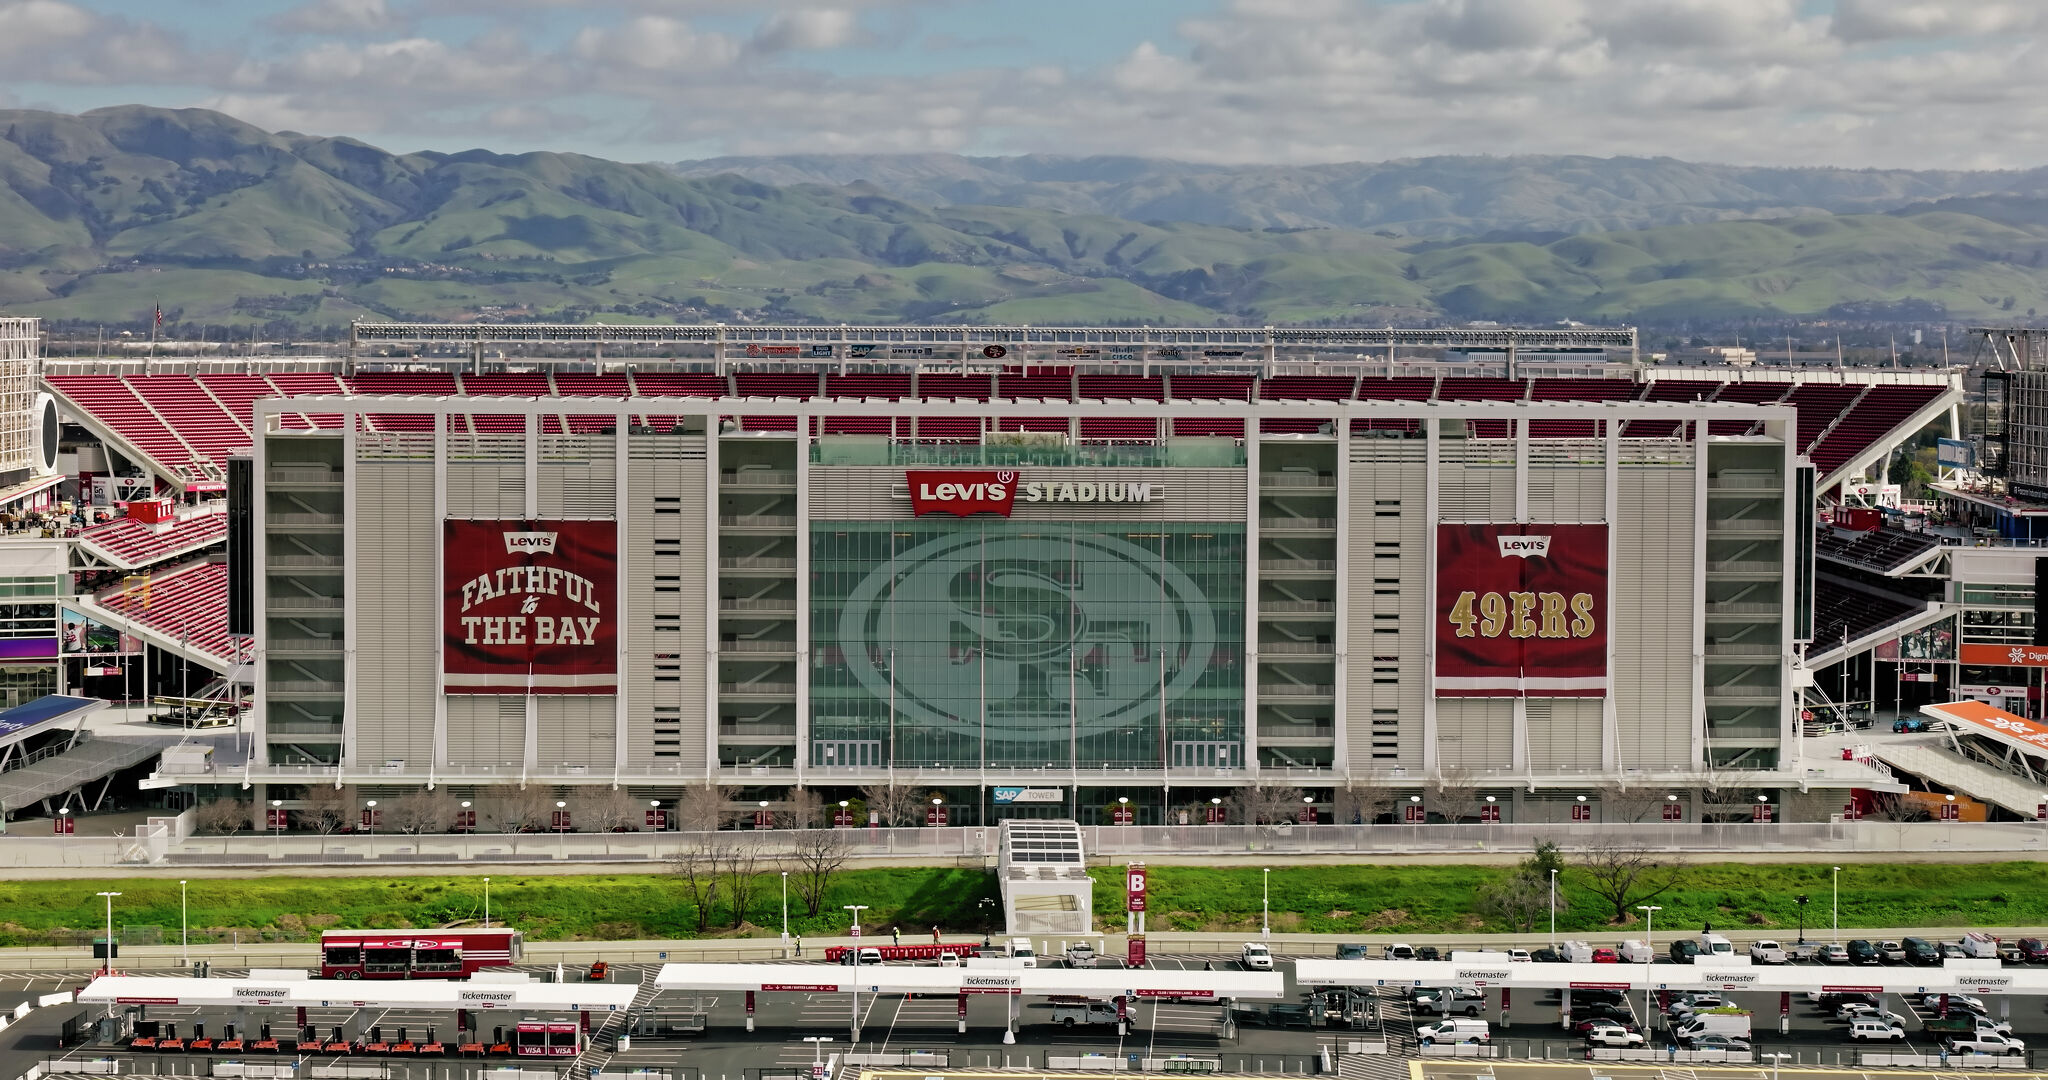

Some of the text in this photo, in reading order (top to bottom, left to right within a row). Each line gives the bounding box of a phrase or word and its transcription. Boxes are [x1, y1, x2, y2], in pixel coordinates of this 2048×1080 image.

[852, 346, 868, 355] SAP
[1026, 482, 1150, 501] STADIUM
[461, 565, 600, 614] FAITHFUL
[520, 594, 541, 614] to
[1449, 591, 1595, 638] 49ERS
[461, 616, 600, 646] THE BAY
[995, 790, 1017, 800] SAP
[1130, 874, 1145, 892] B
[1459, 970, 1508, 979] ticketmaster
[1706, 974, 1755, 982] ticketmaster
[1960, 977, 2009, 985] ticketmaster
[236, 988, 286, 997] ticketmaster
[462, 992, 512, 1001] ticketmaster
